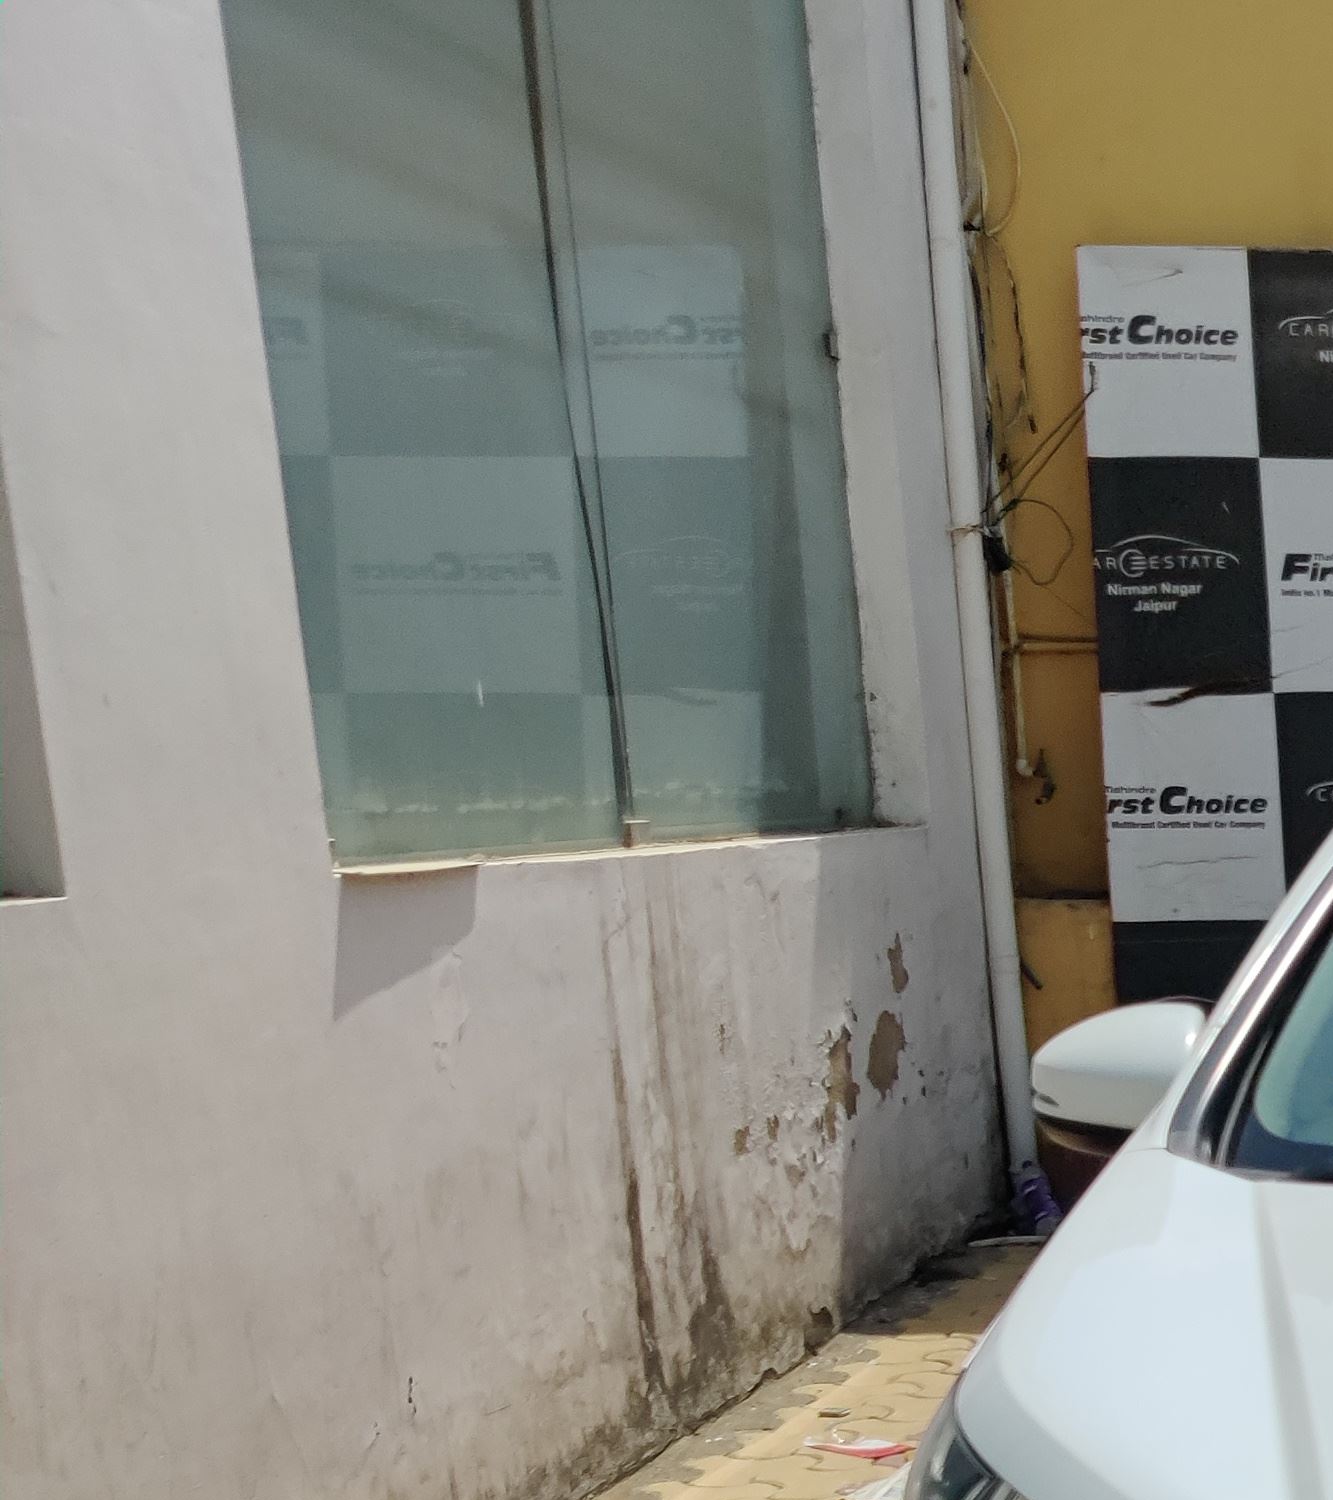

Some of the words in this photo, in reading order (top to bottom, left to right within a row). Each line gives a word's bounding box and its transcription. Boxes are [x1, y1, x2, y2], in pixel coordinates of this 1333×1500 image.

[1080, 326, 1124, 345] rst
[1128, 315, 1238, 345] Choice
[1107, 583, 1157, 595] Nirman
[1161, 582, 1202, 596] Nagar
[1134, 600, 1177, 613] Jaipur
[1107, 797, 1154, 813] rst
[1159, 786, 1268, 814] Choice
